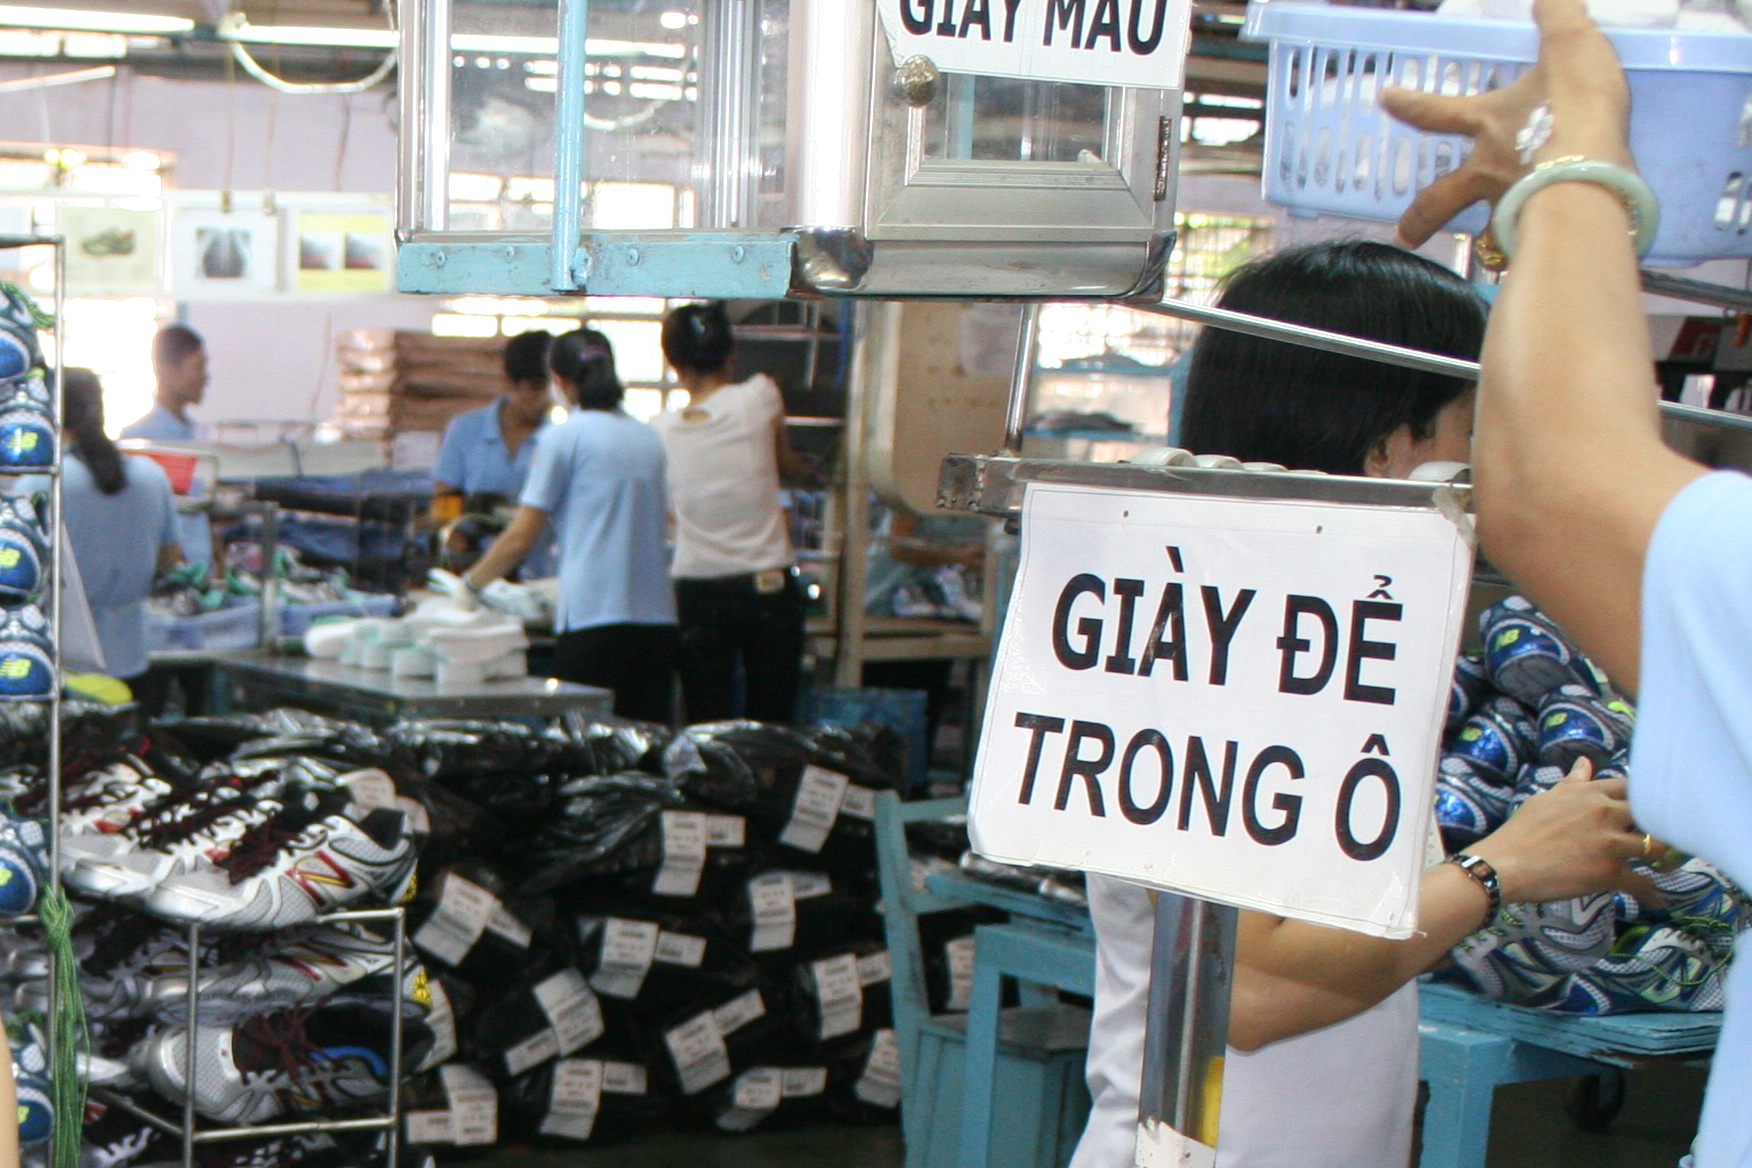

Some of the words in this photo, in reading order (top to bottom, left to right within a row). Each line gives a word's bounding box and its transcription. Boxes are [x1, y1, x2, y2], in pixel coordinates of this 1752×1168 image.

[1051, 545, 1257, 686] GIÀY
[1276, 574, 1404, 705] ĐỂ
[1014, 711, 1305, 846] TRONG
[1334, 733, 1401, 861] Ô
